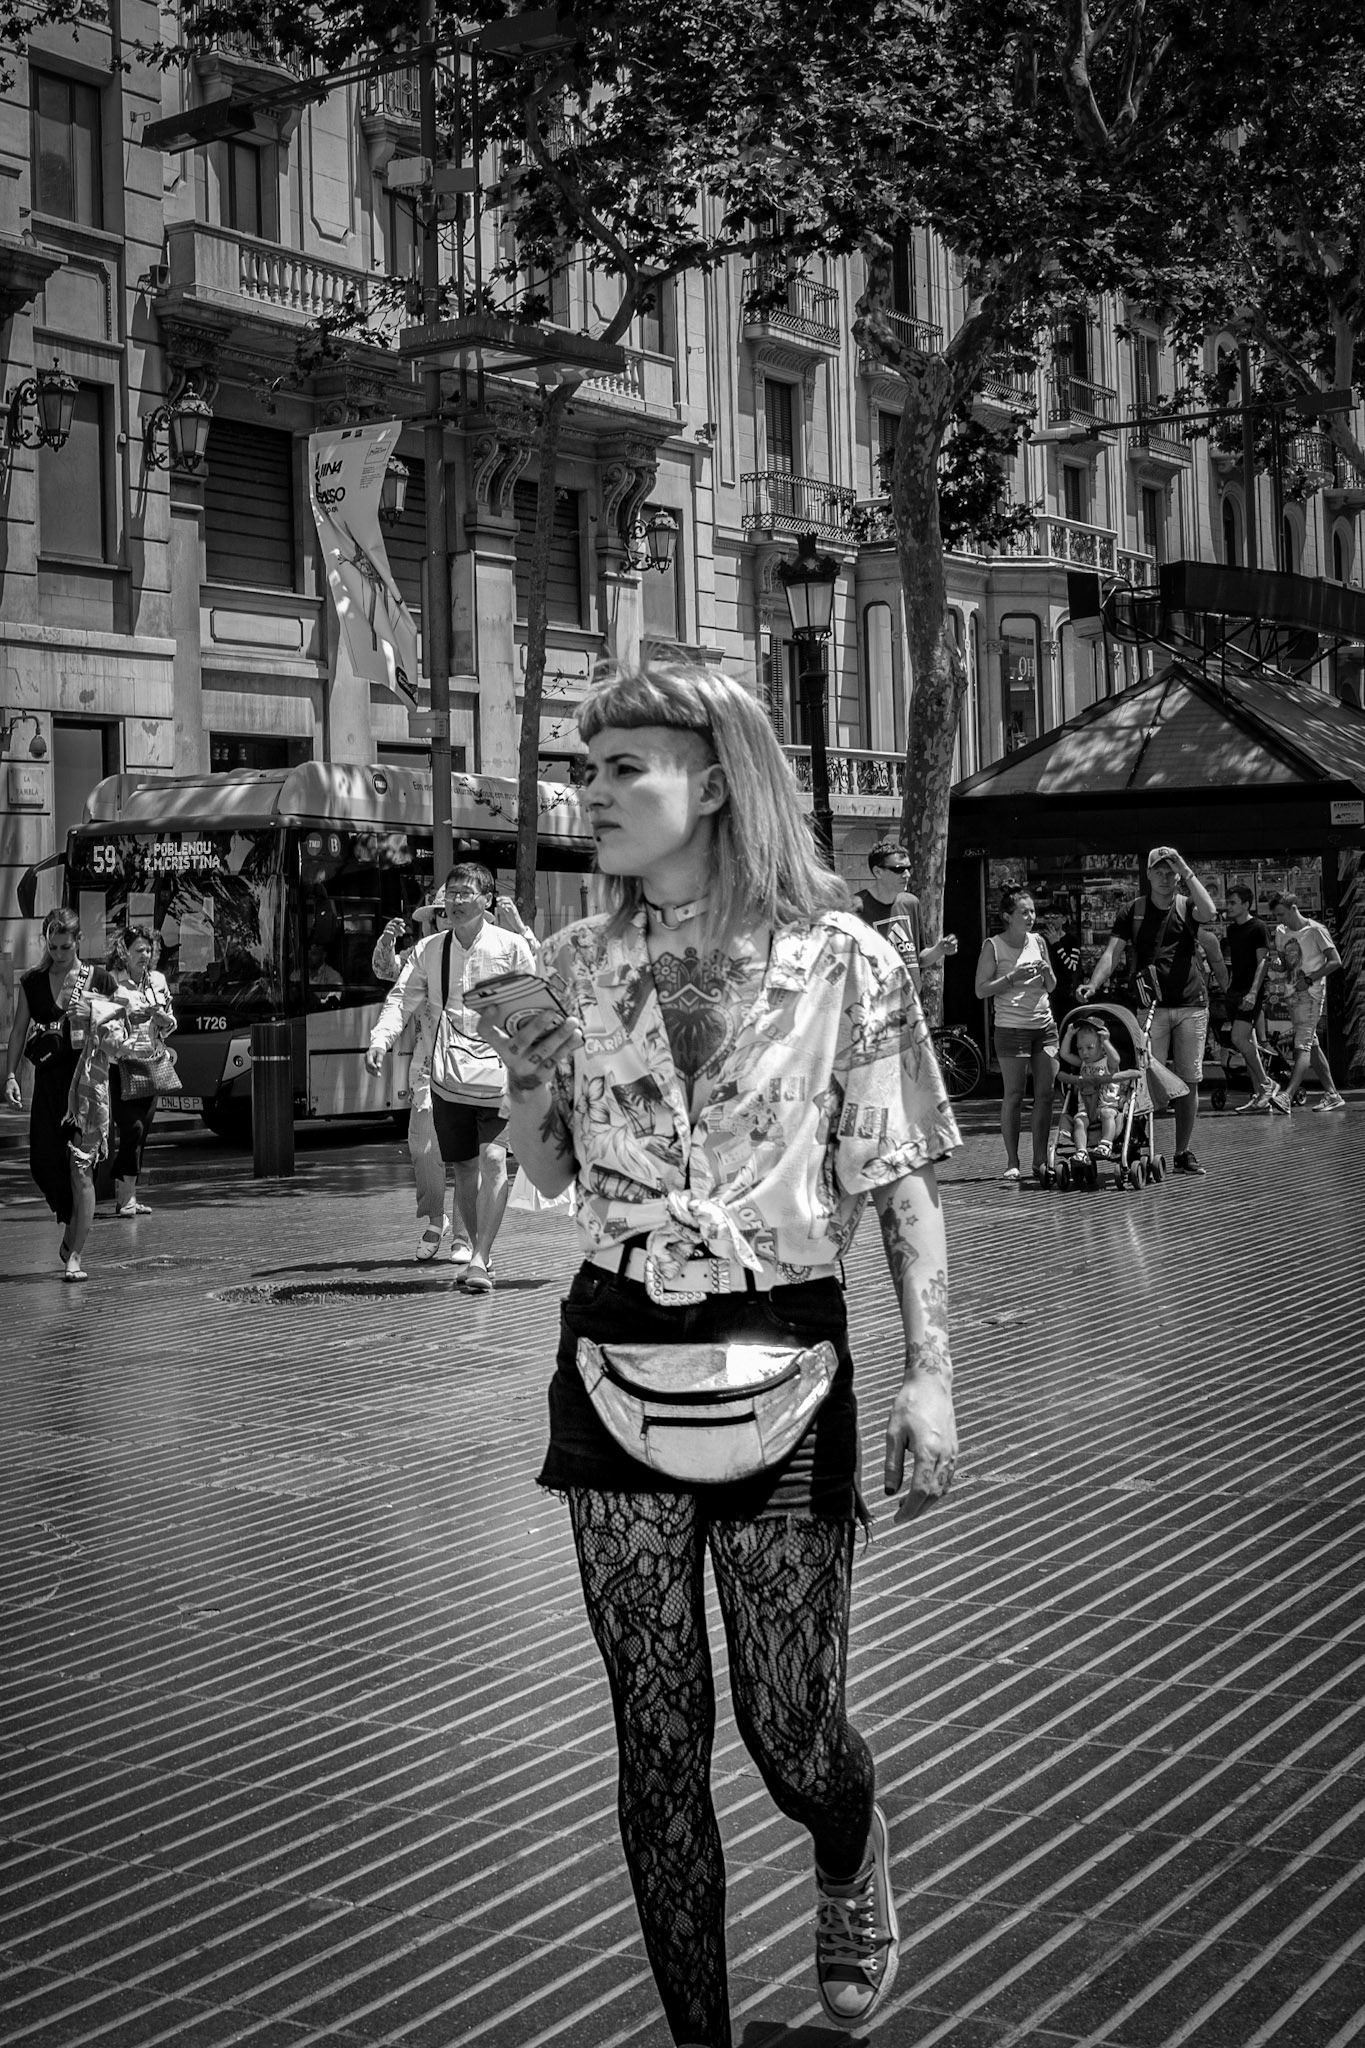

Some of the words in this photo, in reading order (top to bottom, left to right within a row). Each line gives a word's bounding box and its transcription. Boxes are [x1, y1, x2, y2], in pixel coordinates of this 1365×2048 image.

[153, 841, 212, 857] POBLENOU
[93, 844, 117, 874] 59
[195, 1016, 228, 1031] 1726
